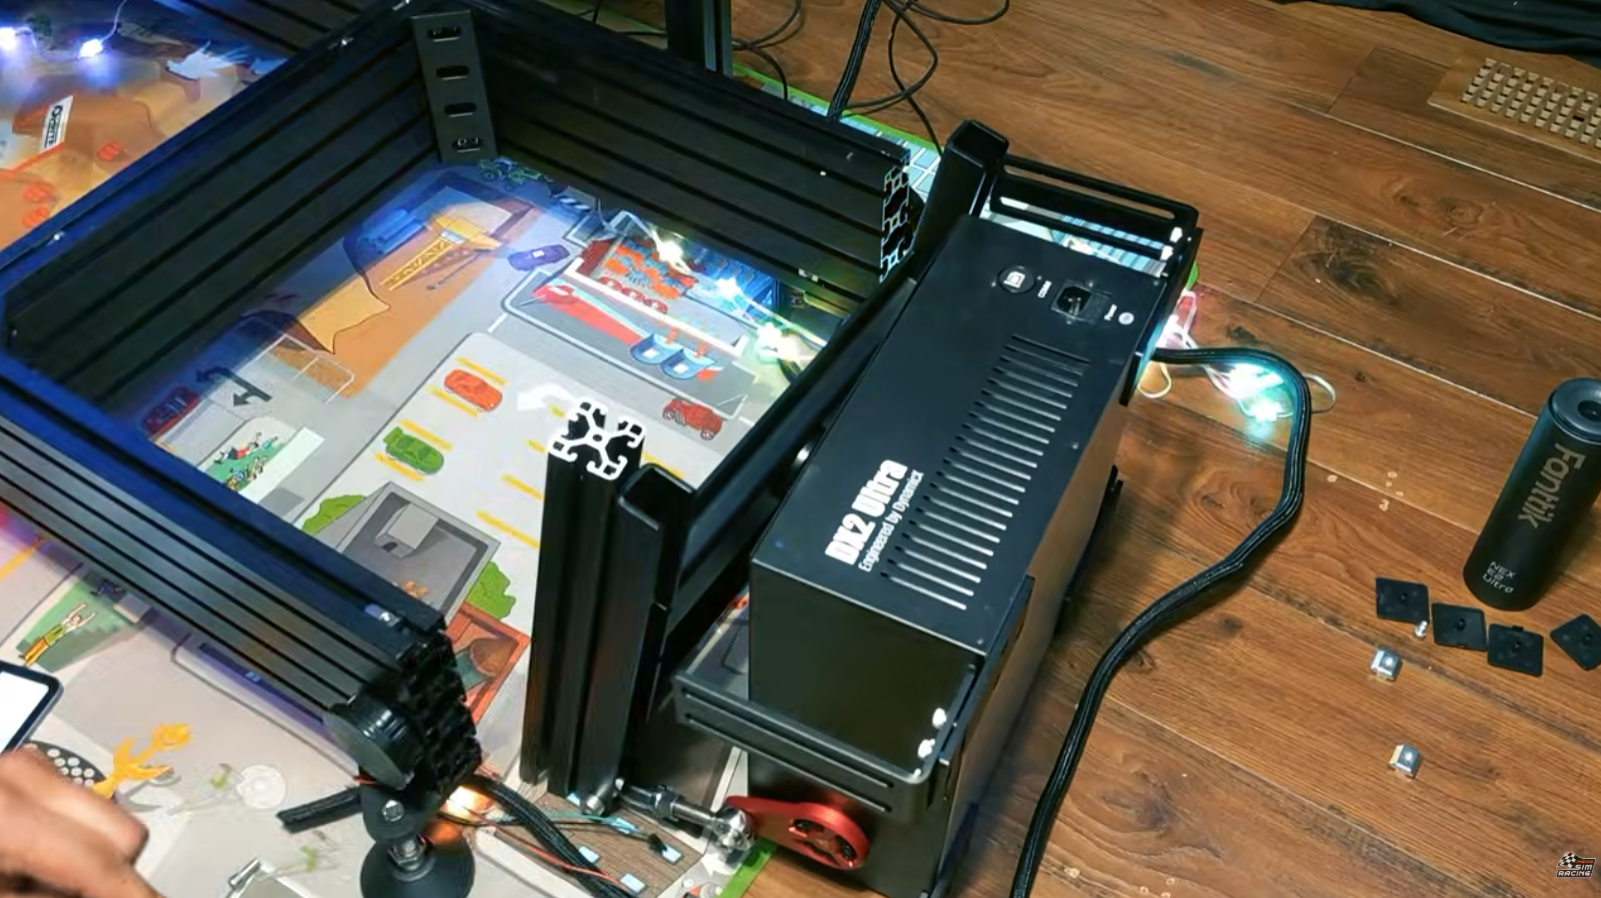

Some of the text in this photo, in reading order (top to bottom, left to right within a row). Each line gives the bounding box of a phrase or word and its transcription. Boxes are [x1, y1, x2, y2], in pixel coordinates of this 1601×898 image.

[851, 459, 908, 517] Ultra
[1517, 442, 1587, 530] Fanttik
[858, 521, 895, 572] Engineered
[885, 510, 903, 524] by
[1490, 561, 1517, 579] NEX
[1482, 573, 1515, 594] Ultra
